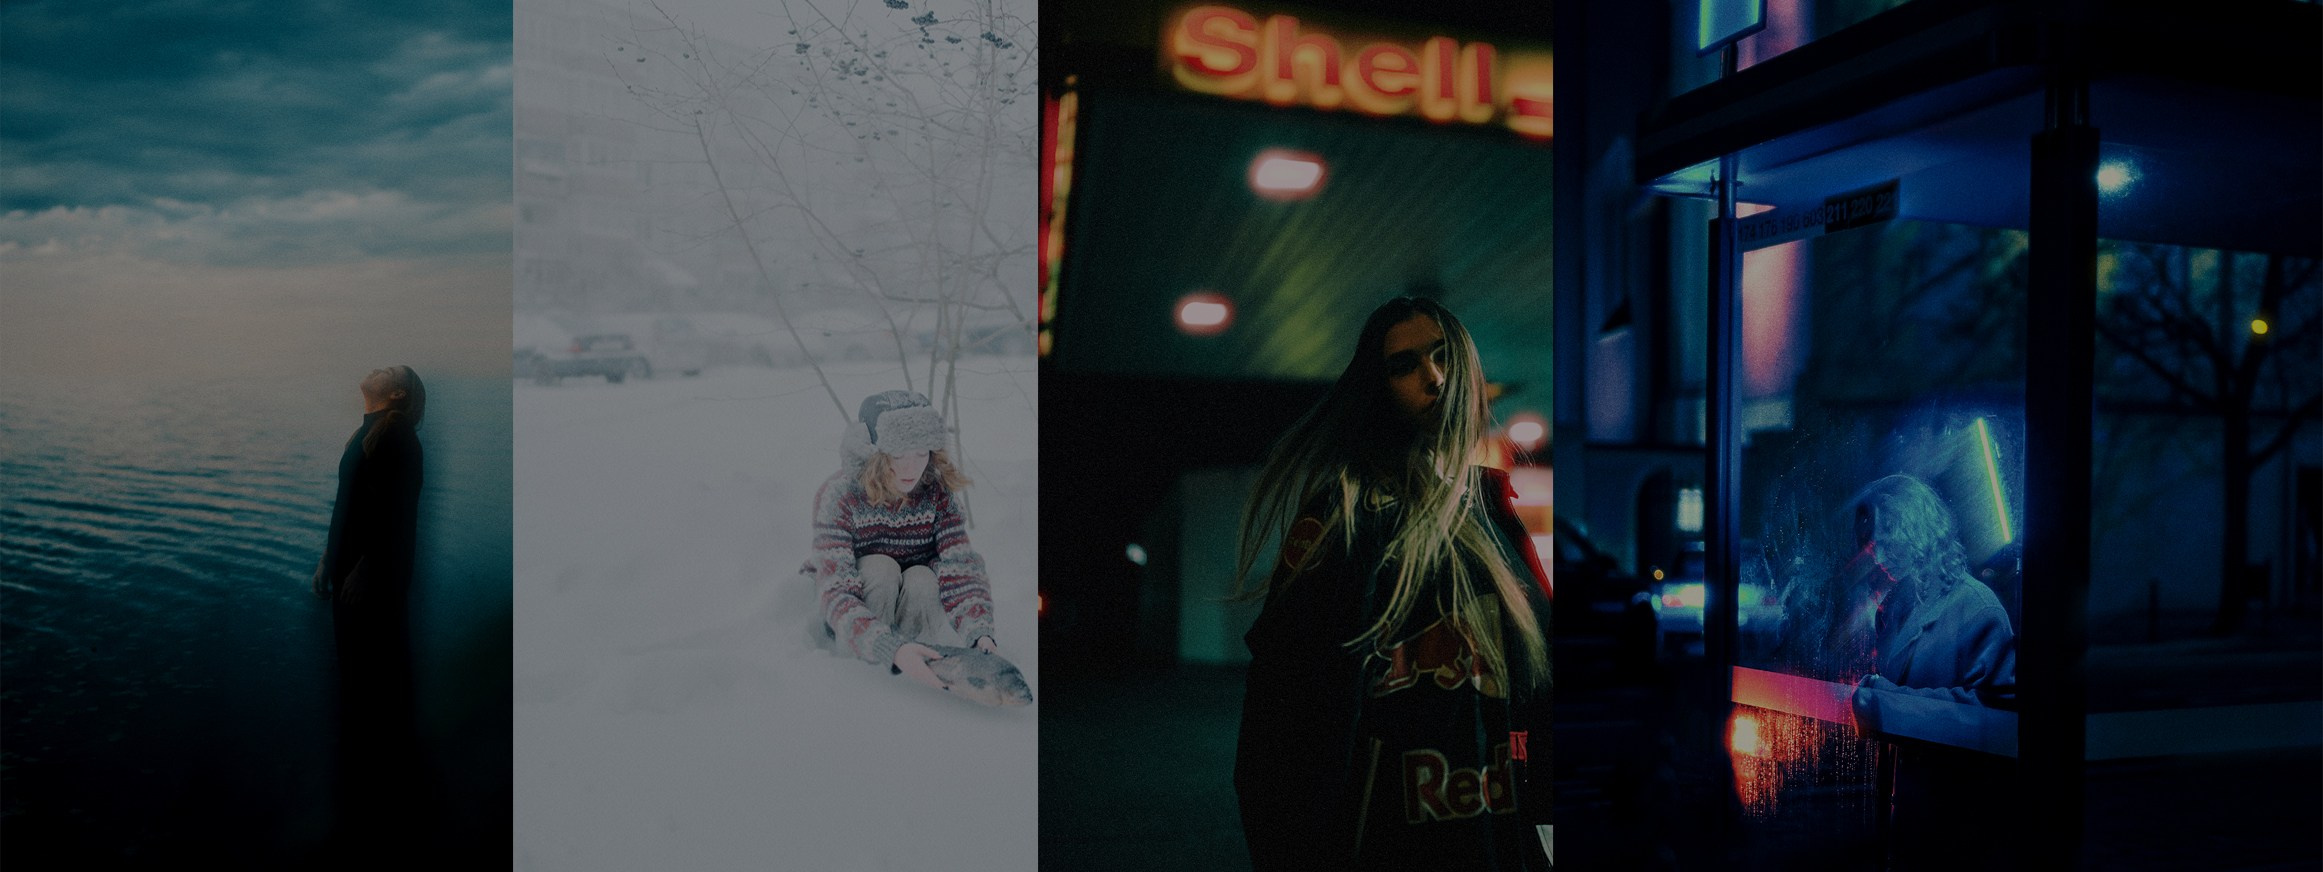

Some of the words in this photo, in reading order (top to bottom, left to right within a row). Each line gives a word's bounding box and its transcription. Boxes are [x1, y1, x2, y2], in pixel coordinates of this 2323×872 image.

[1174, 5, 1497, 120] Shell
[1826, 201, 1848, 224] 211
[1850, 195, 1873, 218] 220
[1402, 742, 1517, 825] Red
